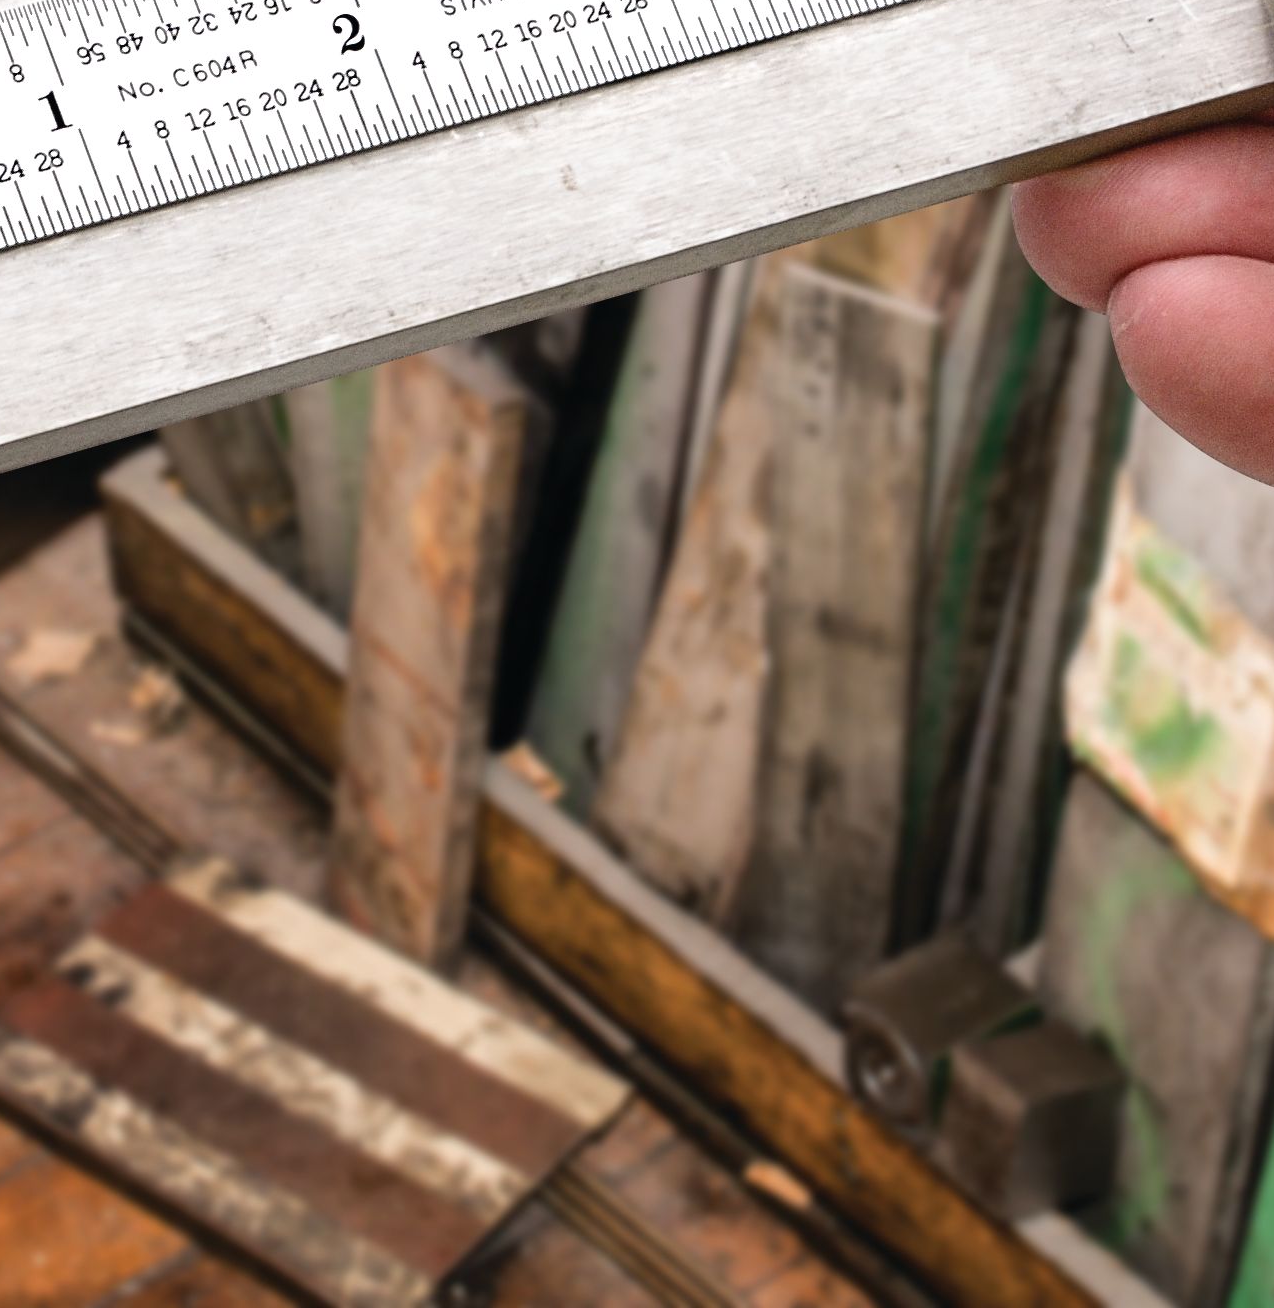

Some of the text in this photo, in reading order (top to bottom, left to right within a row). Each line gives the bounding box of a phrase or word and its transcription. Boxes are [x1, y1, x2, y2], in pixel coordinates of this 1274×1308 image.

[228, 2, 257, 24] 24
[155, 23, 180, 44] 40
[188, 14, 218, 35] 32
[77, 43, 105, 64] 56
[116, 33, 143, 54] 48
[9, 64, 24, 82] 8
[38, 91, 73, 132] 1
[333, 14, 365, 54] 2
[34, 149, 63, 172] 28
[118, 130, 132, 149] 4
[155, 120, 169, 138] 8
[185, 109, 215, 131] 12
[223, 99, 251, 120] 16
[259, 89, 286, 111] 20
[294, 79, 324, 101] 24
[332, 69, 360, 91] 28
[413, 52, 427, 69] 4
[449, 41, 463, 59] 8
[478, 30, 508, 52] 12
[514, 20, 541, 42] 16
[549, 11, 576, 33] 20
[583, 2, 612, 23] 24
[118, 83, 163, 101] No.
